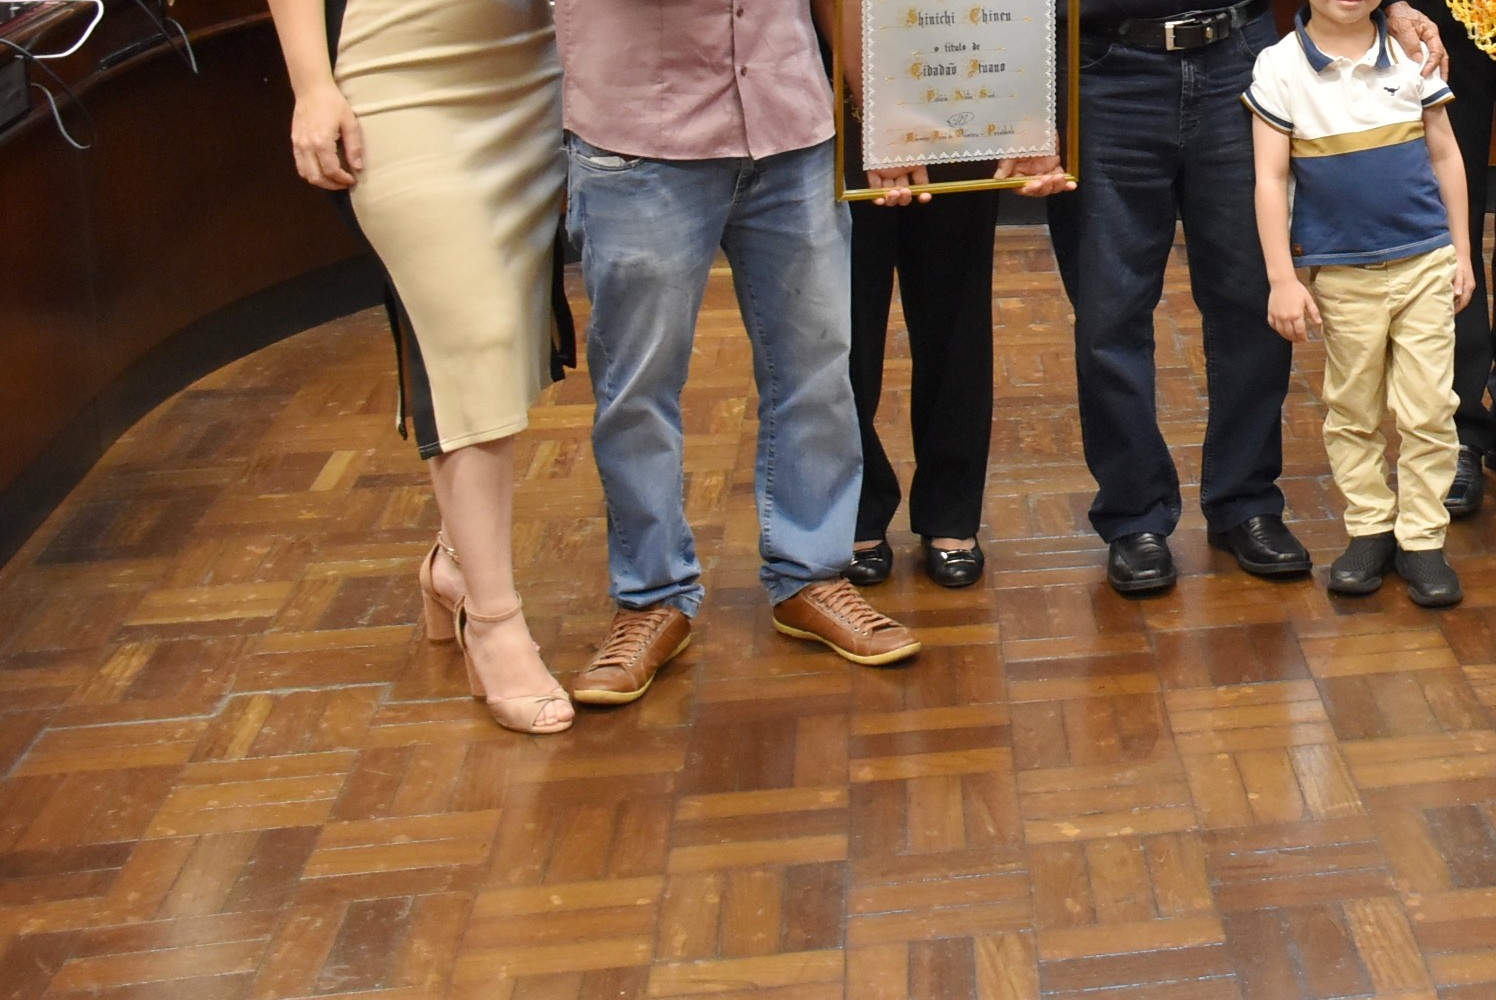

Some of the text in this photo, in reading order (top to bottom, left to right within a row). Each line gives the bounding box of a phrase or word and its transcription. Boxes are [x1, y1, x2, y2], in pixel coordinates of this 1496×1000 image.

[906, 7, 1011, 27] Shinichi Chinen
[972, 42, 980, 50] de
[911, 62, 957, 79] Cidadão
